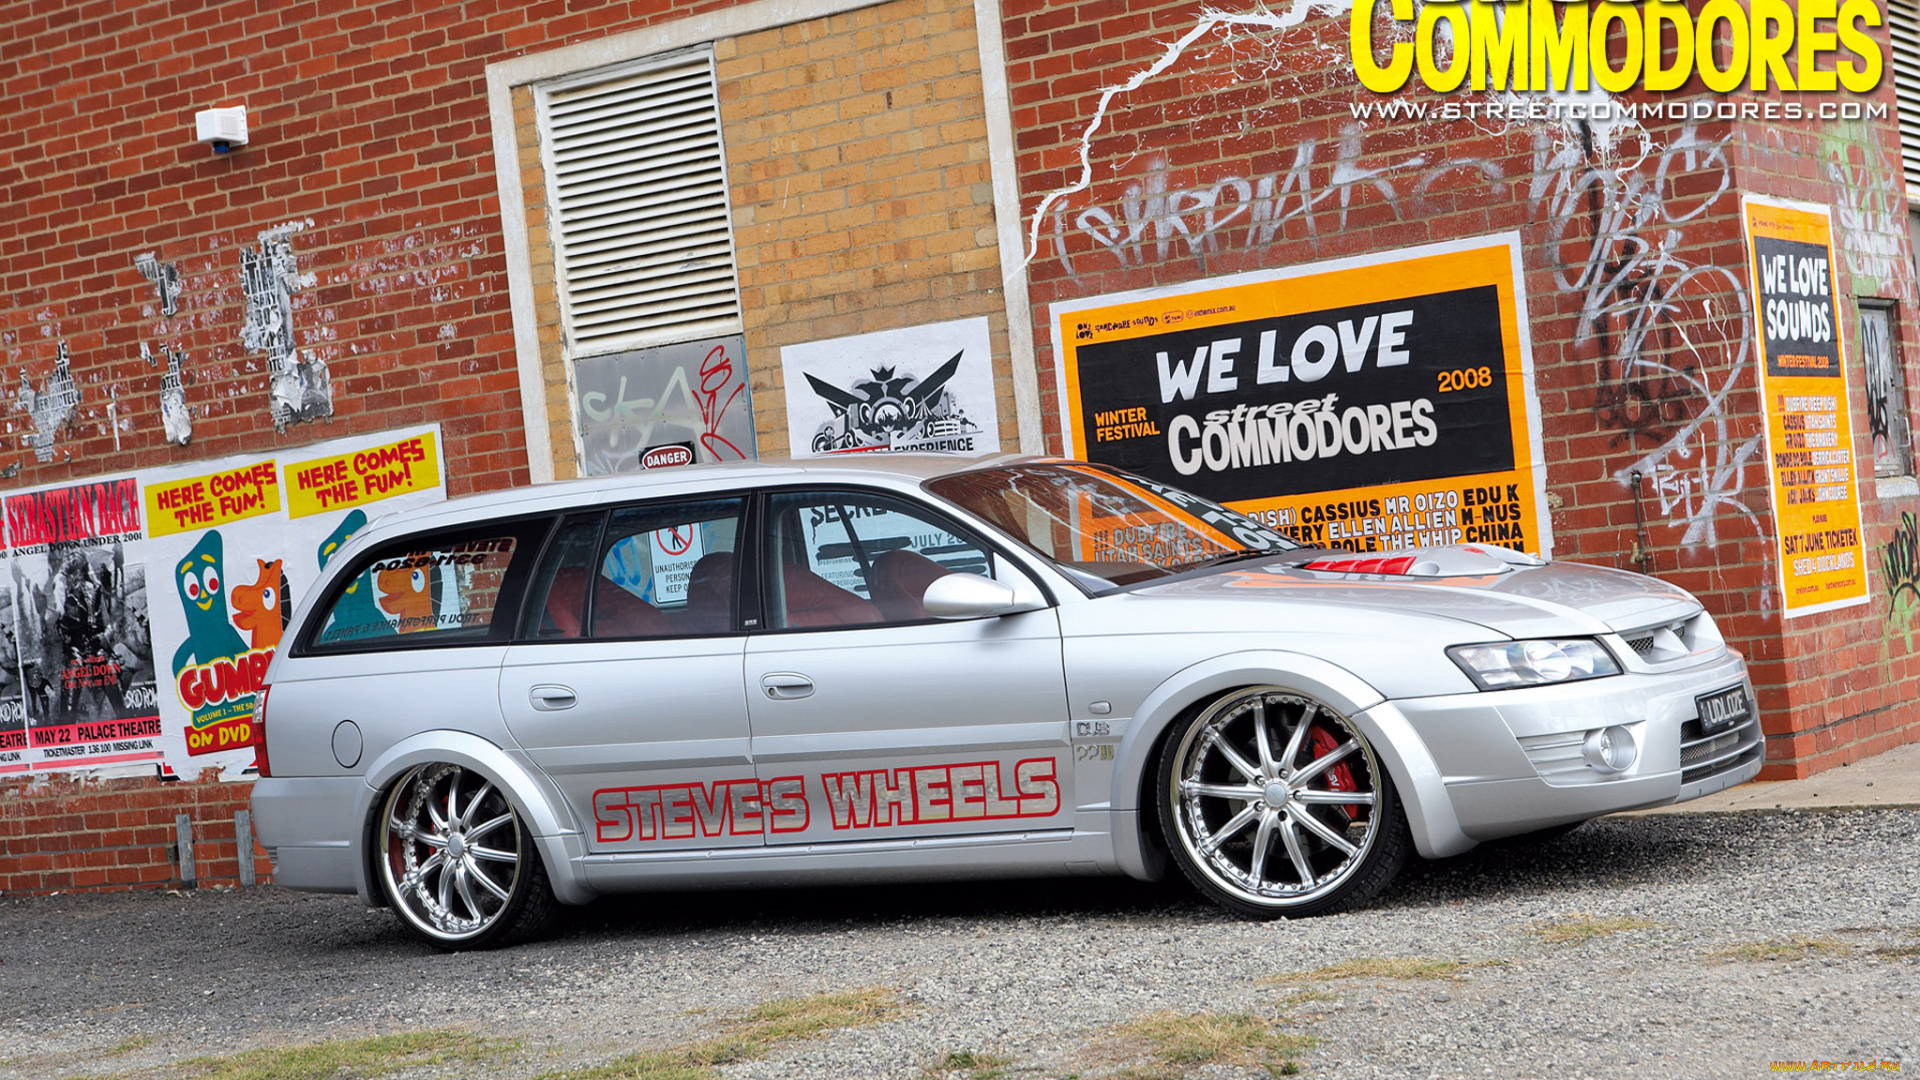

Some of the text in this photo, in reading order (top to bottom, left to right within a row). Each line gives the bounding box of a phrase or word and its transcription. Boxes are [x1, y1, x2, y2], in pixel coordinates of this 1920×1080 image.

[1761, 254, 1829, 297] WE LOVE
[1766, 298, 1831, 344] SOUNDS
[1156, 310, 1414, 404] WE LOVE
[1437, 366, 1493, 393] 2008
[1094, 407, 1147, 429] WINTER
[1202, 392, 1339, 426] street
[1096, 421, 1161, 443] FESTIVAL
[1167, 398, 1438, 476] COMMODORES
[297, 439, 425, 490] HERE COMES
[646, 451, 688, 467] DANGER
[157, 463, 277, 510] HERE COMES
[316, 463, 413, 507] THE FUN!
[6, 484, 96, 548] SEBASTIAN
[95, 478, 141, 536] BACH
[174, 485, 266, 528] THE FUN!
[1301, 499, 1380, 523] CASSIUS
[1385, 496, 1411, 516] MR
[1414, 490, 1458, 512] OIZO
[1463, 486, 1501, 506] EDU
[1506, 484, 1519, 502] K
[1113, 522, 1187, 546] DUBFIRE
[1328, 516, 1386, 539] ELLEN
[1391, 509, 1457, 533] ALLIEN
[1461, 503, 1521, 525] M-NUS
[12, 545, 47, 557] ANGEL
[49, 540, 81, 552] DOWN
[83, 535, 121, 548] UNDER
[911, 533, 943, 548] JULY
[1379, 532, 1415, 551] THE
[1418, 528, 1462, 547] WHIP
[1466, 522, 1523, 543] CHINA
[1784, 534, 1798, 555] SAT
[1825, 528, 1858, 549] TICKETEK
[1793, 557, 1811, 577] SHED
[1817, 551, 1855, 573] DOCKLANDS
[666, 584, 682, 593] KEEP
[61, 663, 121, 679] ANGEL DOWN
[179, 650, 274, 709] GUMB
[196, 709, 222, 723] VOLUME
[232, 704, 245, 712] THE
[35, 719, 162, 744] MAY 22 PALACE THEATRE
[189, 723, 250, 748] ON DVD
[44, 746, 85, 758] TICKETMASTER
[113, 741, 138, 752] MISSING
[139, 740, 153, 749] LINK
[592, 756, 1062, 843] STEVE'S WHEELS
